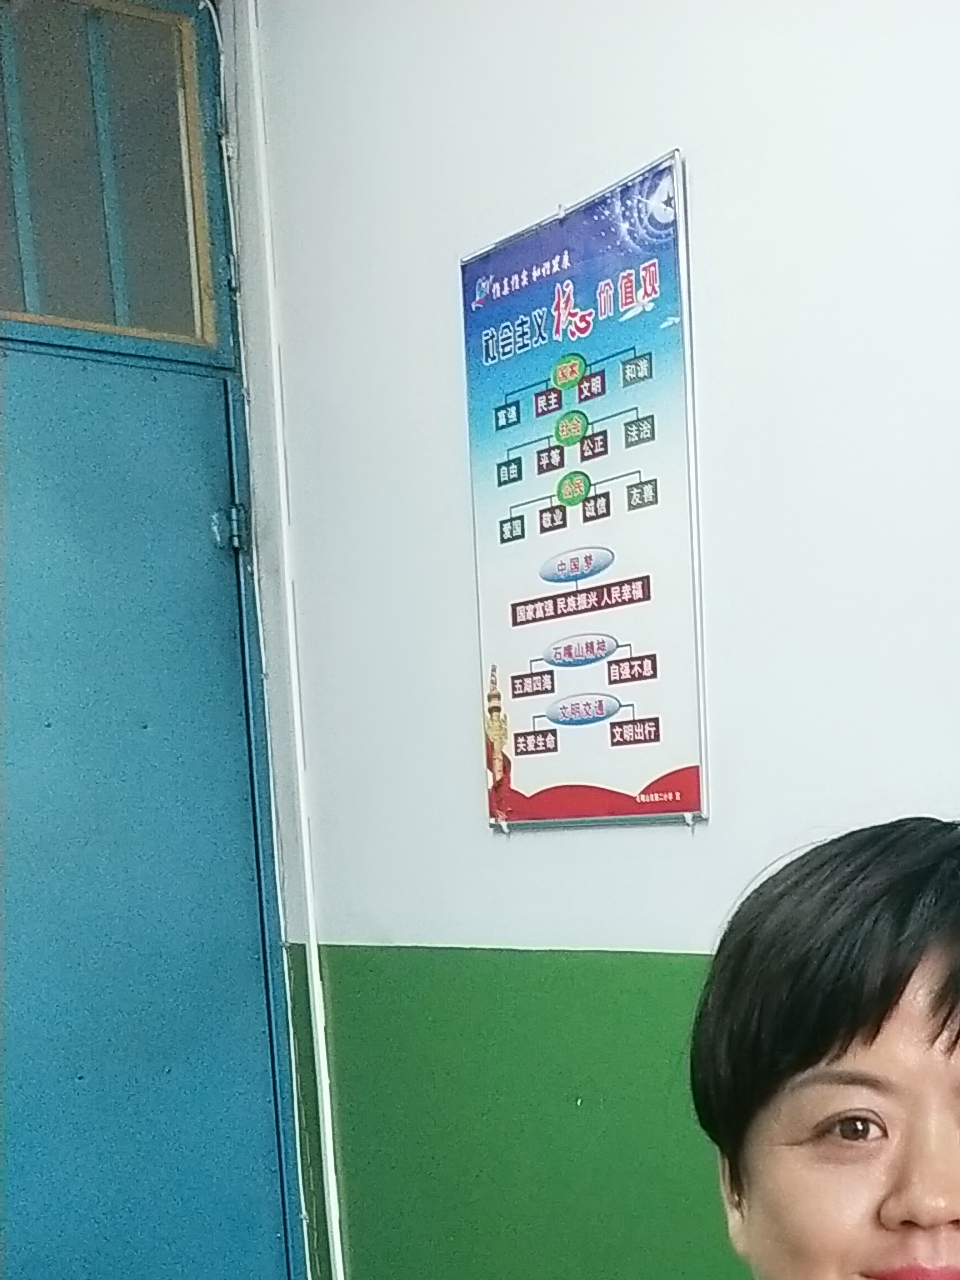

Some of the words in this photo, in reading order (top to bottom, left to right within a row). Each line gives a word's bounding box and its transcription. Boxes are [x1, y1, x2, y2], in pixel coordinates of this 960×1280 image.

[580, 376, 602, 399] 文明
[537, 391, 559, 413] 民主
[583, 436, 605, 457] 公正
[539, 449, 561, 469] 平等
[500, 463, 518, 482] 自由
[557, 552, 593, 574] 中国梦
[610, 659, 654, 682] 自强不息
[516, 732, 556, 753] 关爱生命
[612, 722, 656, 743] 文明出行
